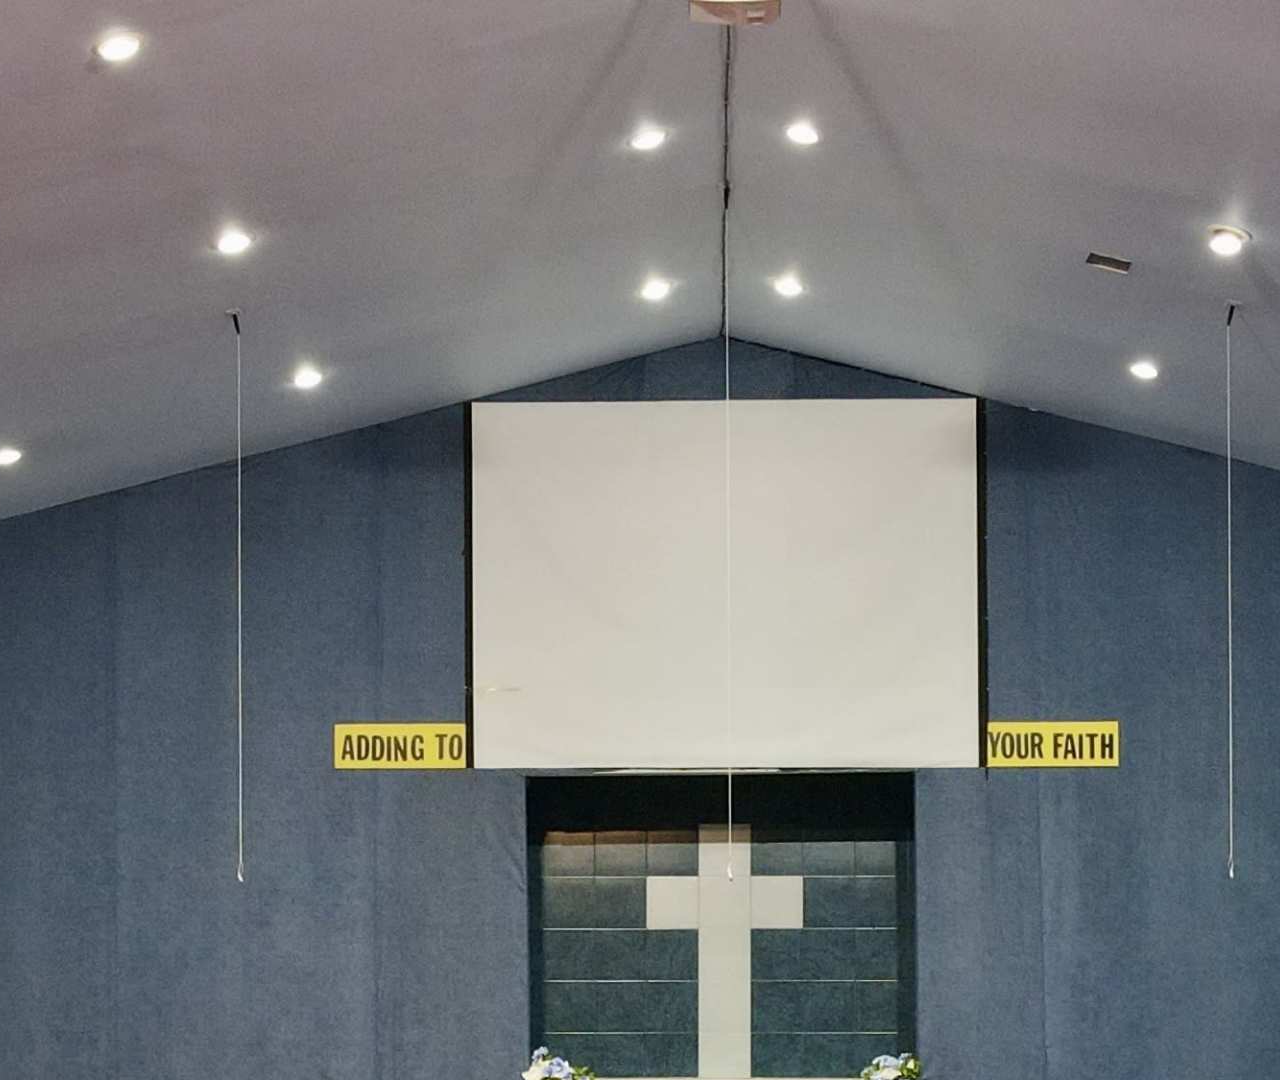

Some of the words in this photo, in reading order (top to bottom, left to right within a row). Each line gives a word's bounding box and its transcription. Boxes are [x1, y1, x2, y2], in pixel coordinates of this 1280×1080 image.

[341, 734, 424, 761] ADDING
[435, 733, 463, 760] TO
[988, 731, 1043, 759] YOUR
[1053, 732, 1114, 760] FAITH
